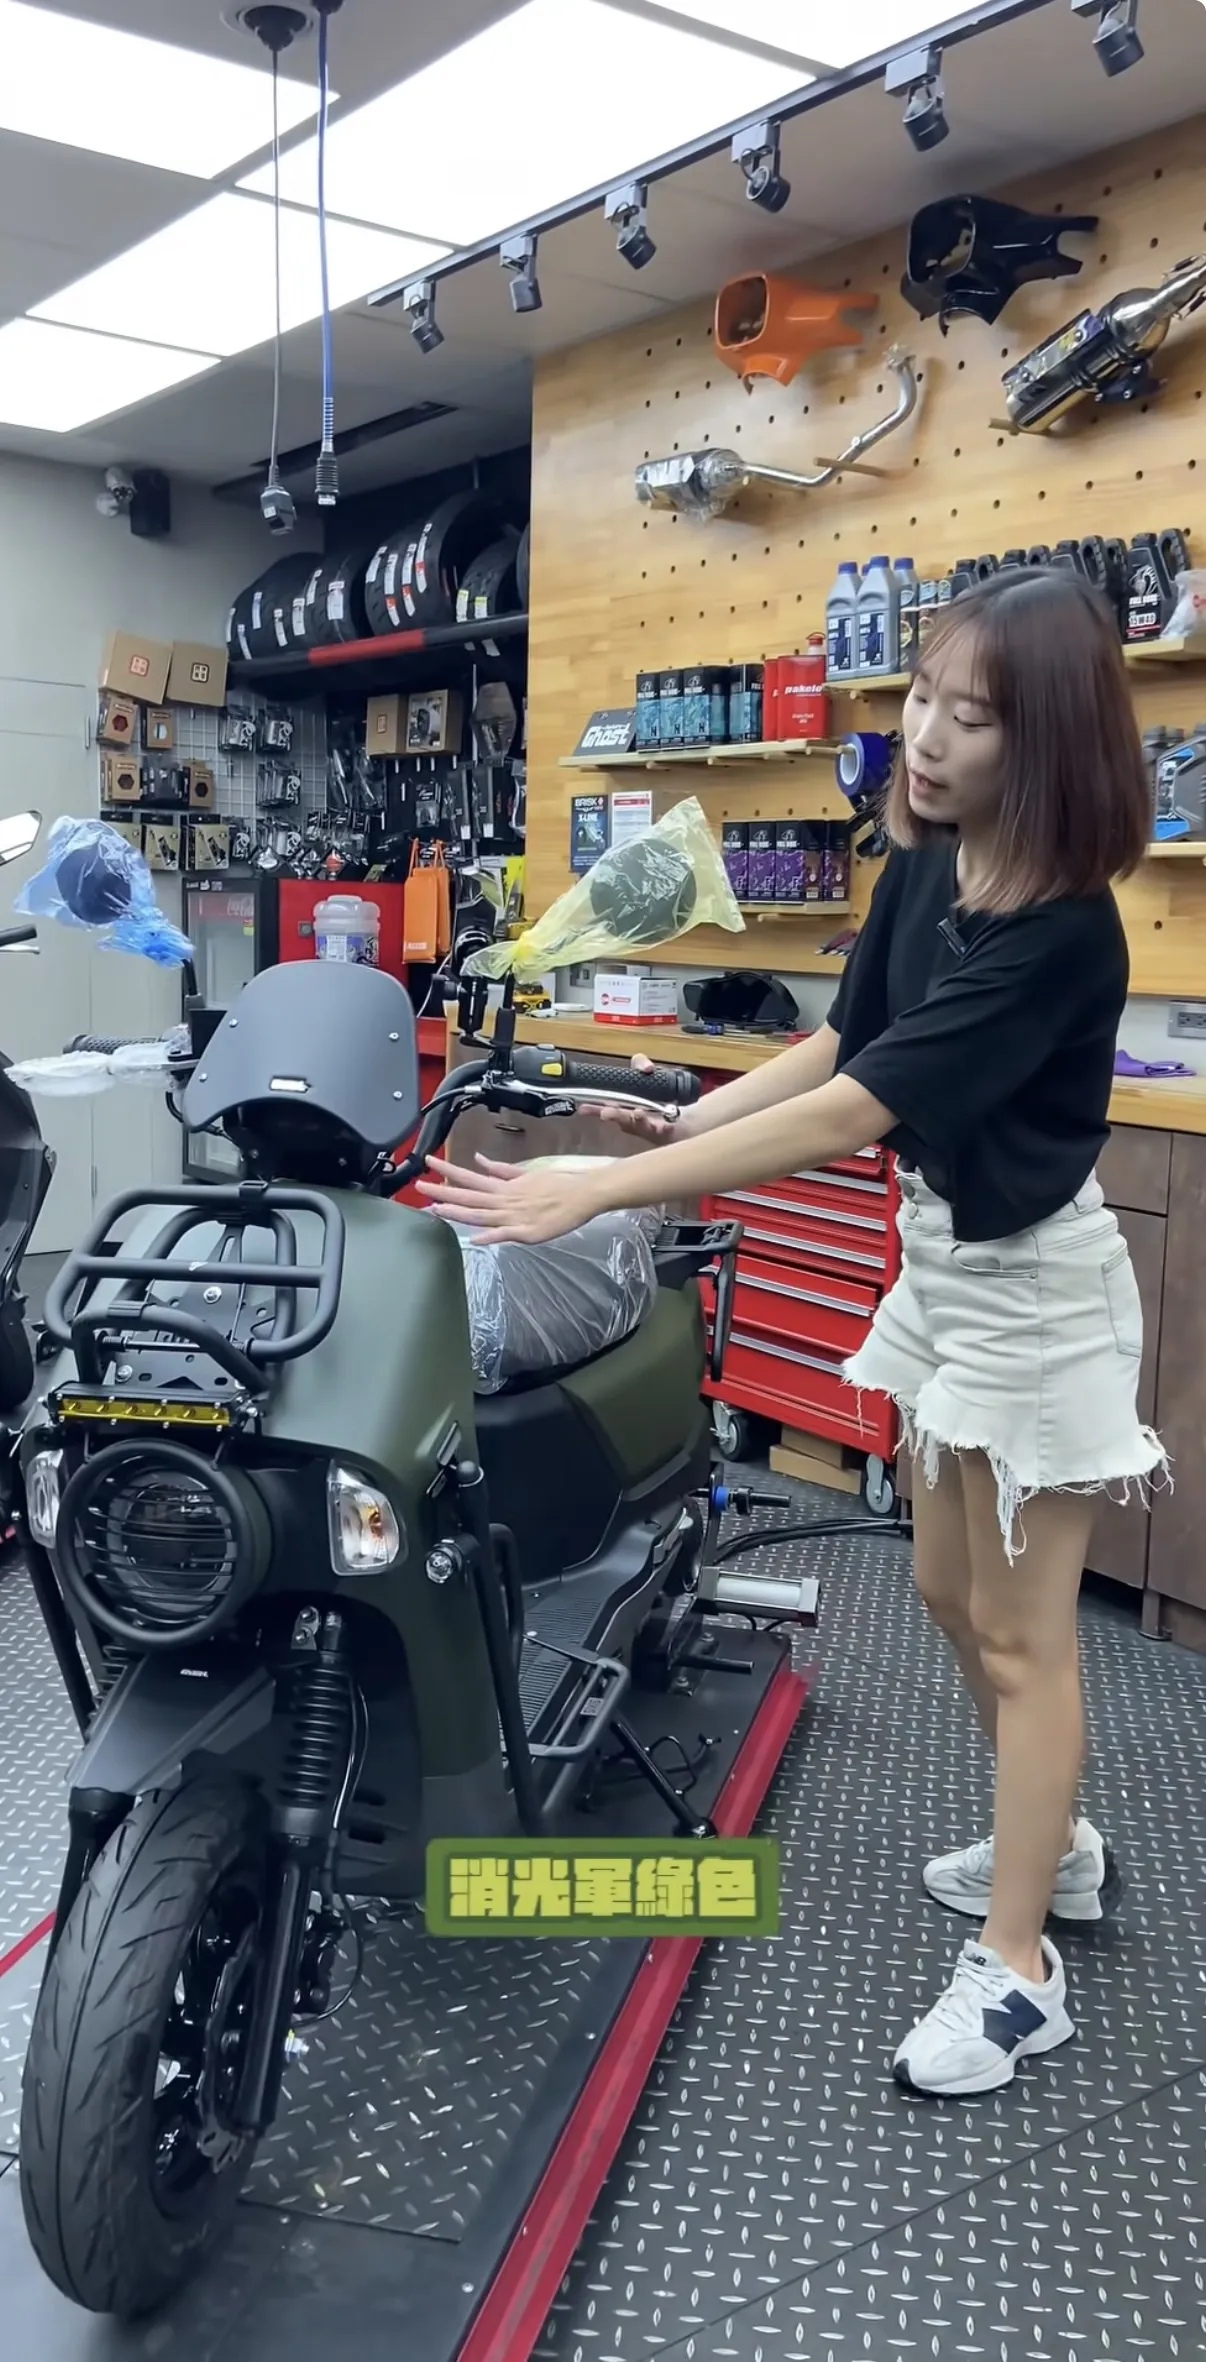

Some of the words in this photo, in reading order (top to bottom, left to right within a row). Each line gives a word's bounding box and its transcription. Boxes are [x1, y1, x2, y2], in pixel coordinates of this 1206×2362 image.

[785, 684, 823, 695] pakelo
[581, 723, 630, 748] Ghost
[575, 797, 597, 807] BRISK
